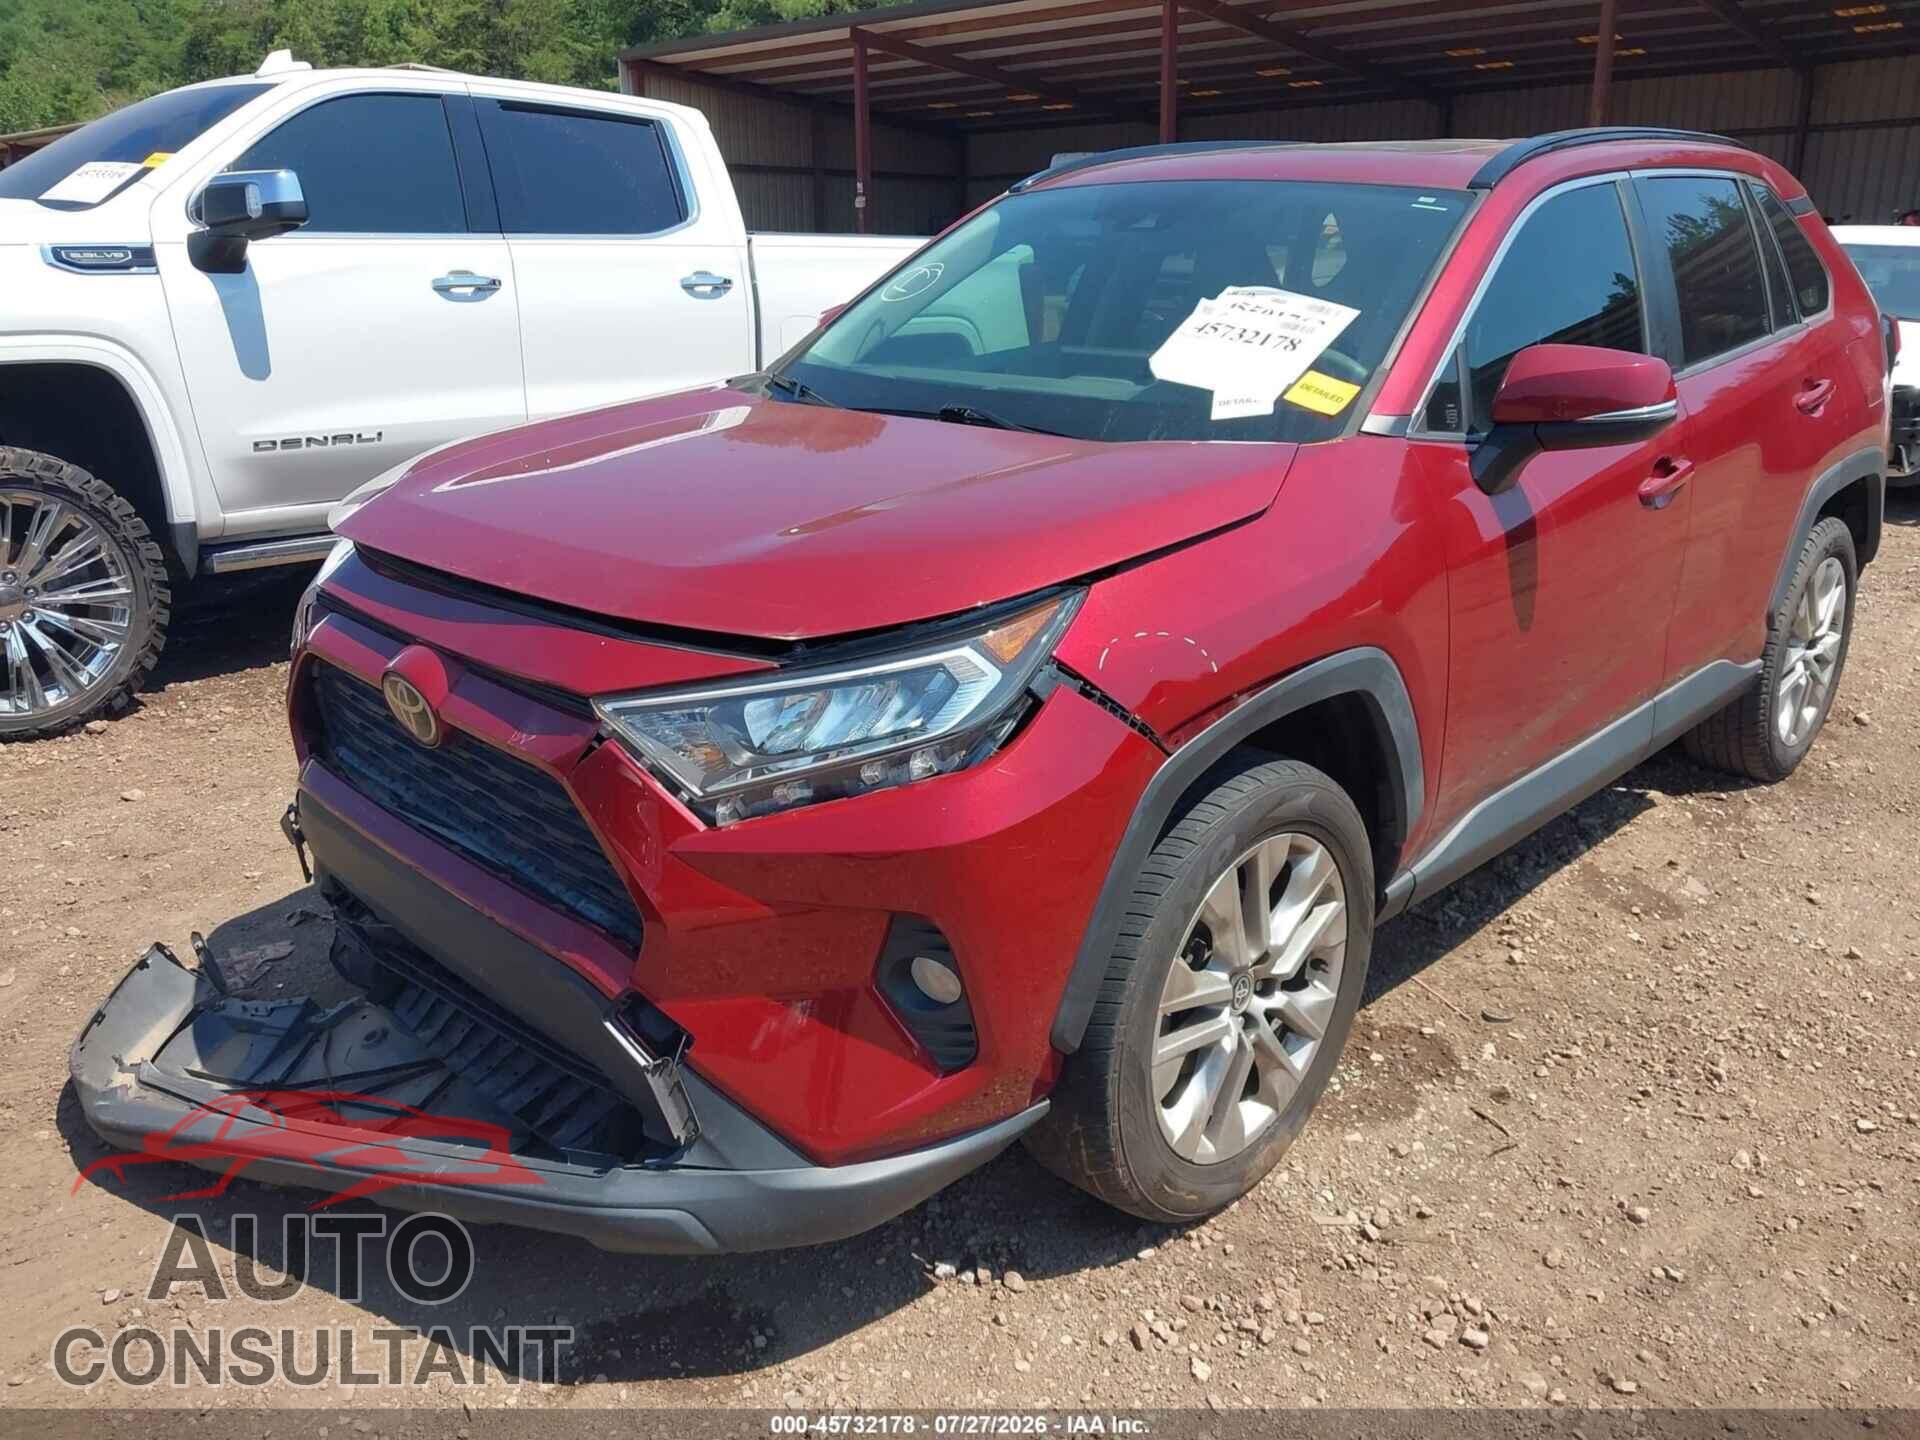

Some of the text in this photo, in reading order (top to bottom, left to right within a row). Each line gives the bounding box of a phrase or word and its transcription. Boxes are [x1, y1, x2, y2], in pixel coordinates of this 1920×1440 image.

[1193, 321, 1303, 352] 45732178
[1299, 382, 1345, 404] DETAILED
[253, 431, 383, 453] DENALI
